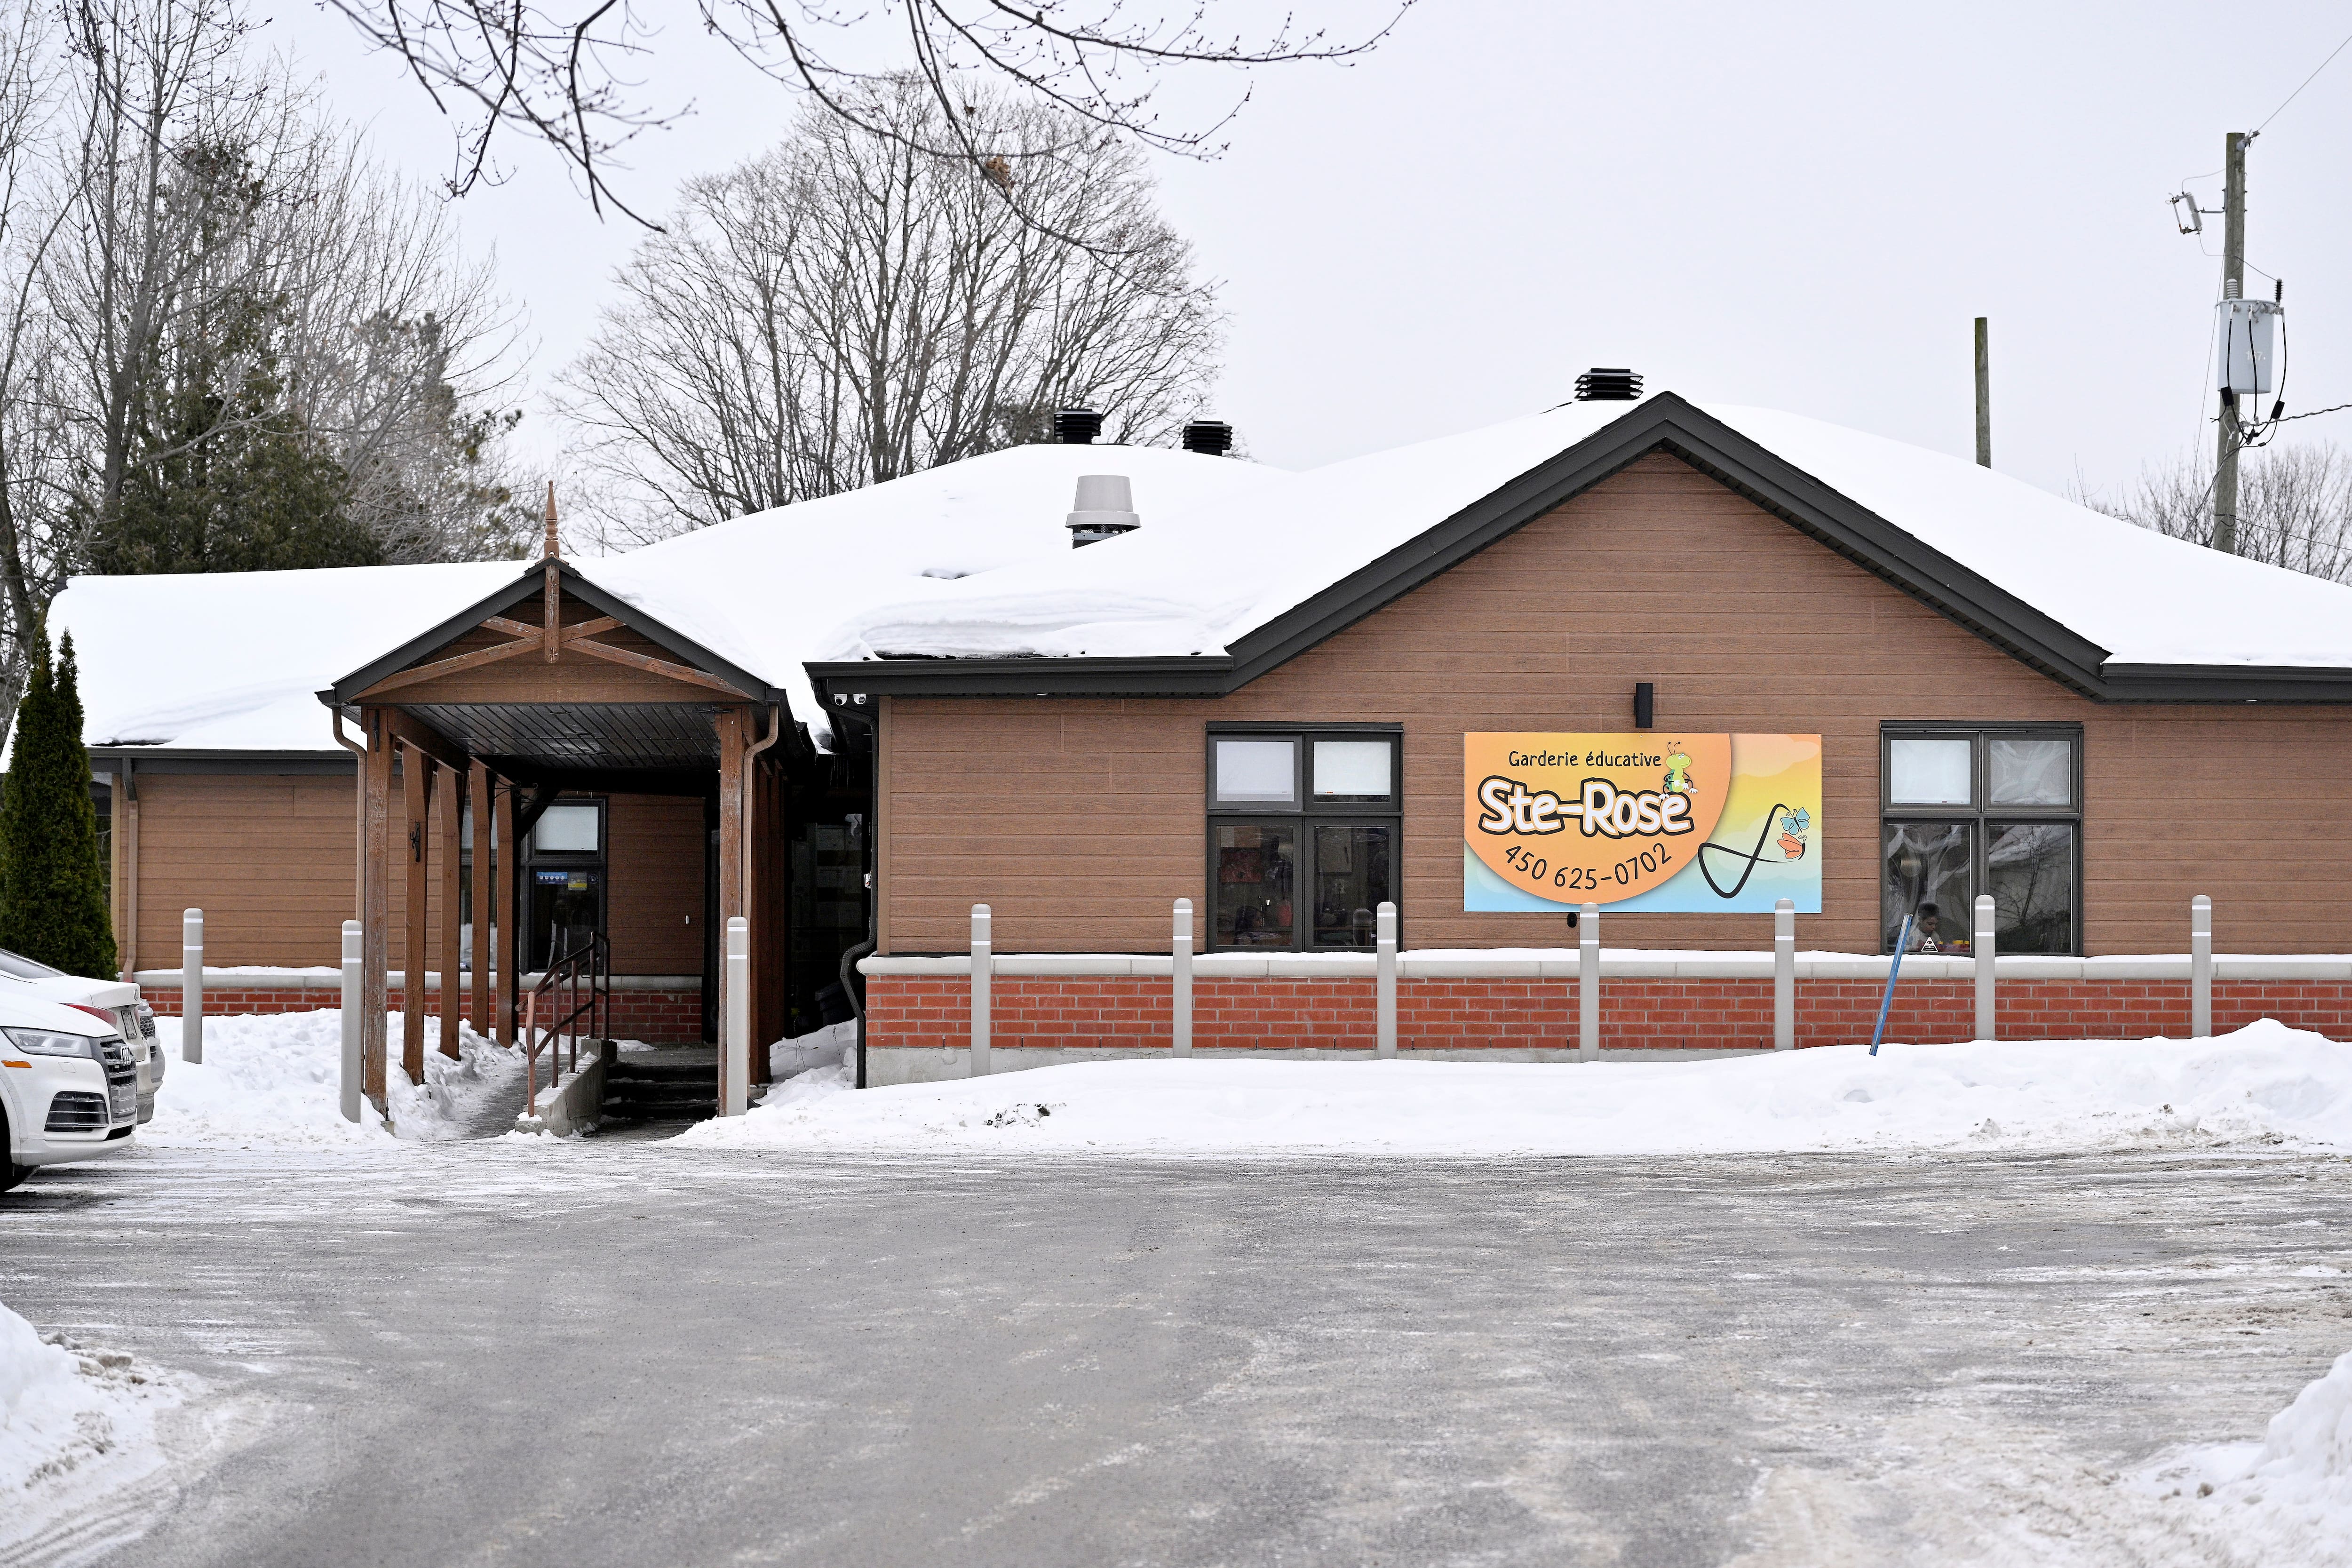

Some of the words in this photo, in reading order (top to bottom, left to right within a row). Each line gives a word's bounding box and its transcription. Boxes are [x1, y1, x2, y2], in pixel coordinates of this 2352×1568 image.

[1510, 750, 1578, 766] Garderie
[1586, 751, 1661, 766] éducative
[1478, 775, 1695, 839] Ste-Rose
[1506, 846, 1547, 879] 450
[1555, 843, 1672, 890] 625-0702
